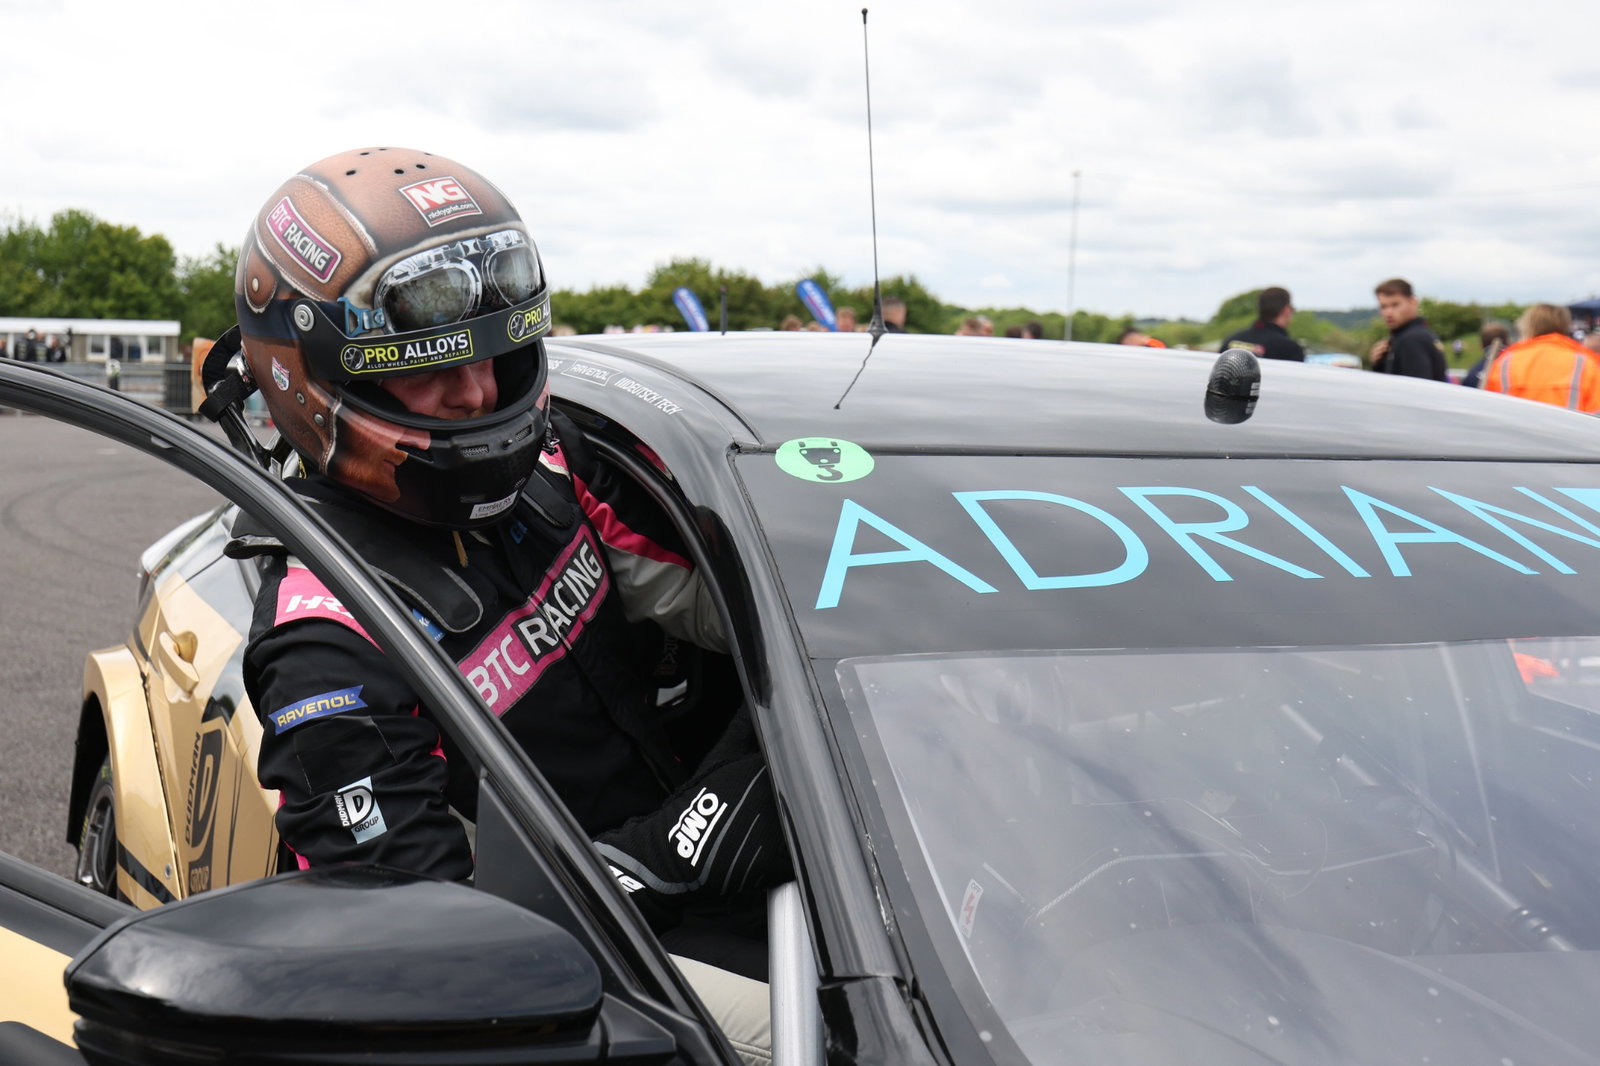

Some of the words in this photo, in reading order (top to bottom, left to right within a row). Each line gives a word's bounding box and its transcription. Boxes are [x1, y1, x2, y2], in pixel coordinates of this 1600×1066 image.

[406, 179, 468, 210] NG
[428, 202, 475, 220] nickygrist.com
[271, 203, 292, 232] BTC
[283, 222, 330, 271] RACING
[525, 307, 542, 329] PRO
[364, 346, 399, 364] PRO
[404, 333, 469, 360] ALLOYS
[444, 349, 470, 359] REPAIRS
[569, 363, 611, 381] RAVENOL
[654, 398, 683, 415] TECH
[814, 485, 1600, 610] ADRIAN
[466, 634, 531, 707] BTC
[518, 541, 603, 656] RACING
[277, 694, 356, 727] RAVENOL
[185, 731, 202, 845] DUDMAN
[334, 794, 350, 827] DUDMAN
[354, 816, 379, 833] GROUP
[675, 792, 719, 859] OMP
[190, 865, 210, 893] GROUP
